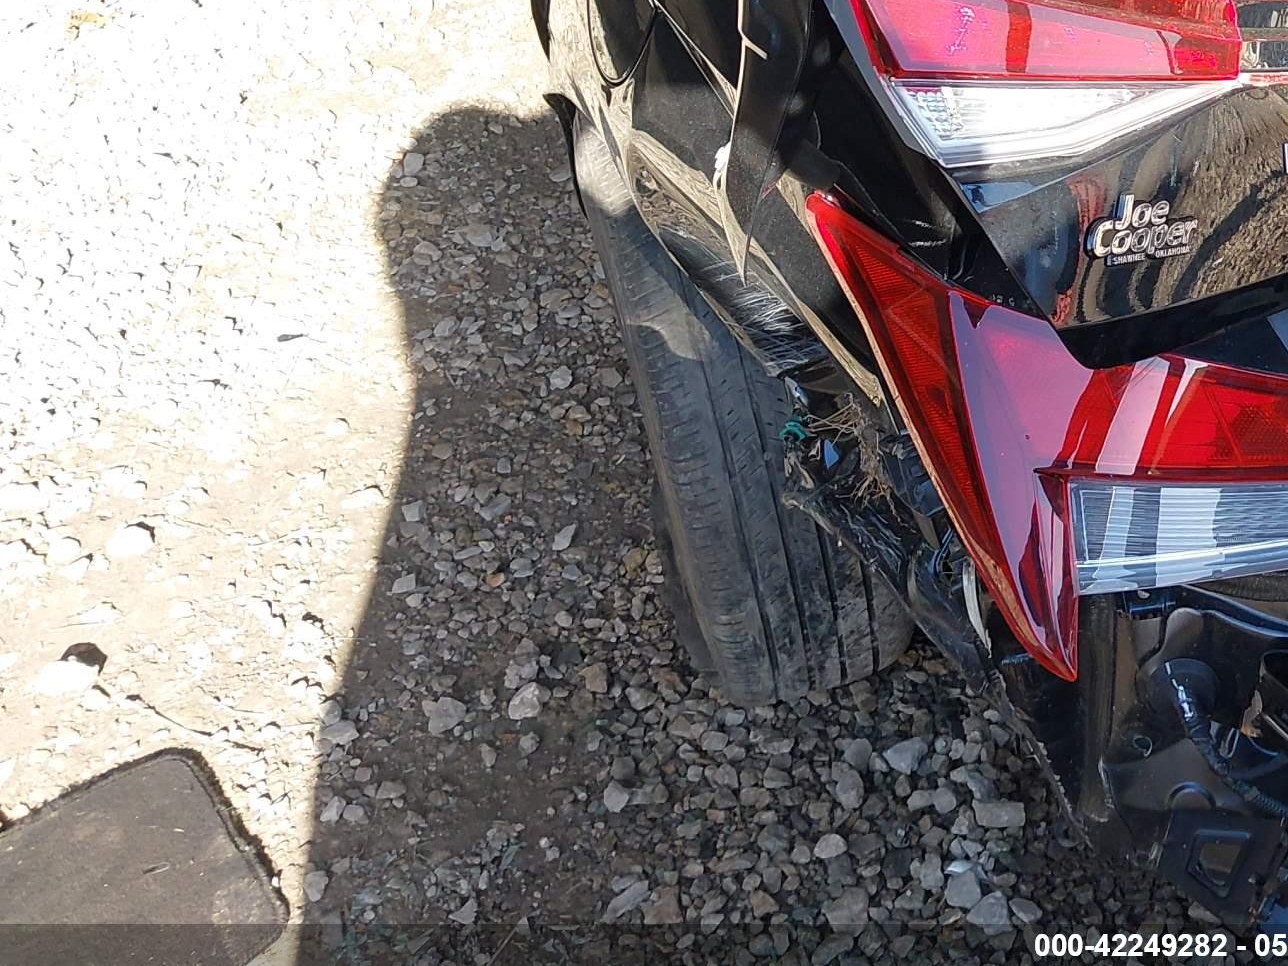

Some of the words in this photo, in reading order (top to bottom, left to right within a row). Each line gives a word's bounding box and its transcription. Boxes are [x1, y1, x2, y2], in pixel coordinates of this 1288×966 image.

[1115, 194, 1170, 230] Joe
[1093, 219, 1199, 257] Cooper
[1111, 252, 1146, 265] SHAWNEE
[1155, 244, 1191, 258] OKLAHOMA
